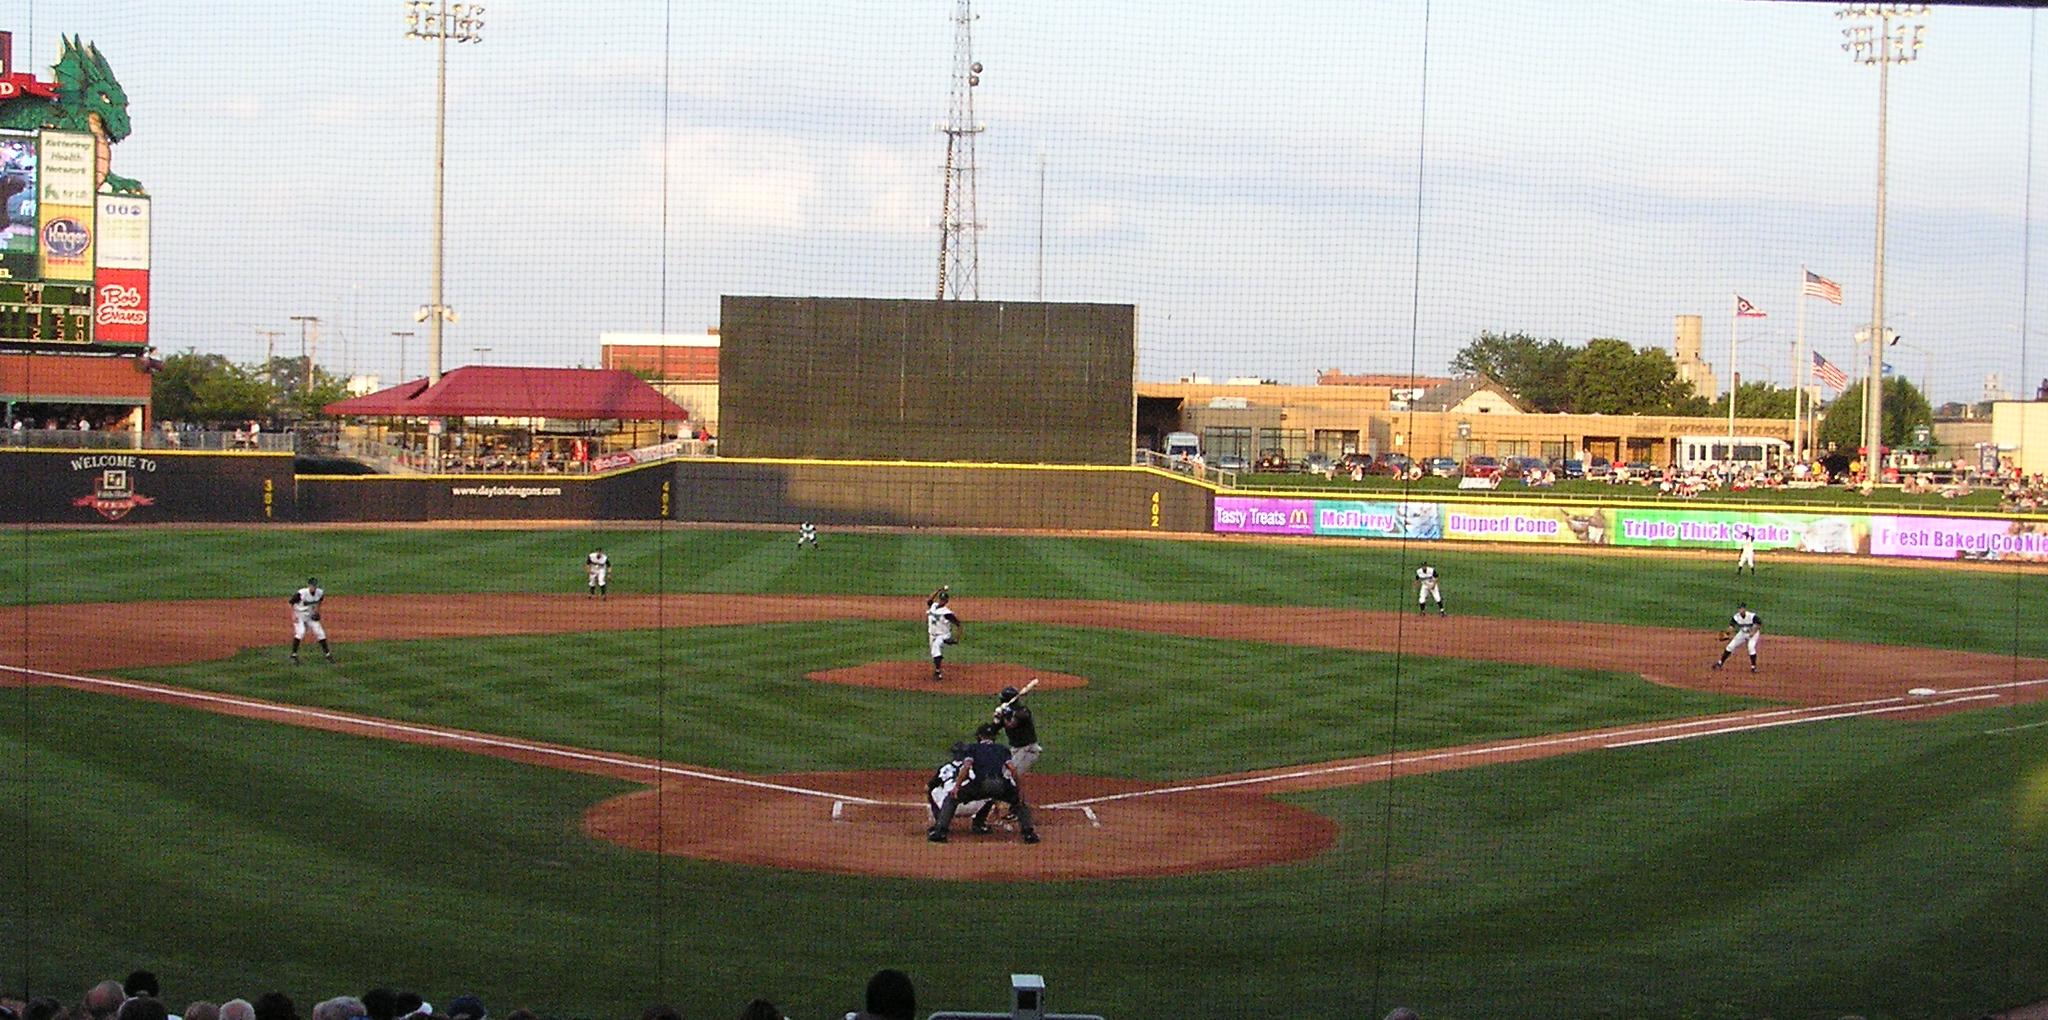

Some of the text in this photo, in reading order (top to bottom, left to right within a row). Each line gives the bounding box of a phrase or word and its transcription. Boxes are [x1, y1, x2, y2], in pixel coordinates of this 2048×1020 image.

[101, 285, 140, 306] Bob
[97, 306, 147, 324] Evans
[71, 455, 156, 472] WELCOME TO
[452, 485, 561, 498] www.daytondragons.com
[1151, 492, 1159, 527] 402
[1216, 506, 1286, 528] Tasty Treats
[1321, 510, 1395, 532] McFlurry
[1450, 514, 1558, 535] Dipped Cone
[1624, 519, 1790, 542] Triple Thick Shake
[1882, 528, 1929, 546] Fresh
[1934, 530, 1985, 549] Baked
